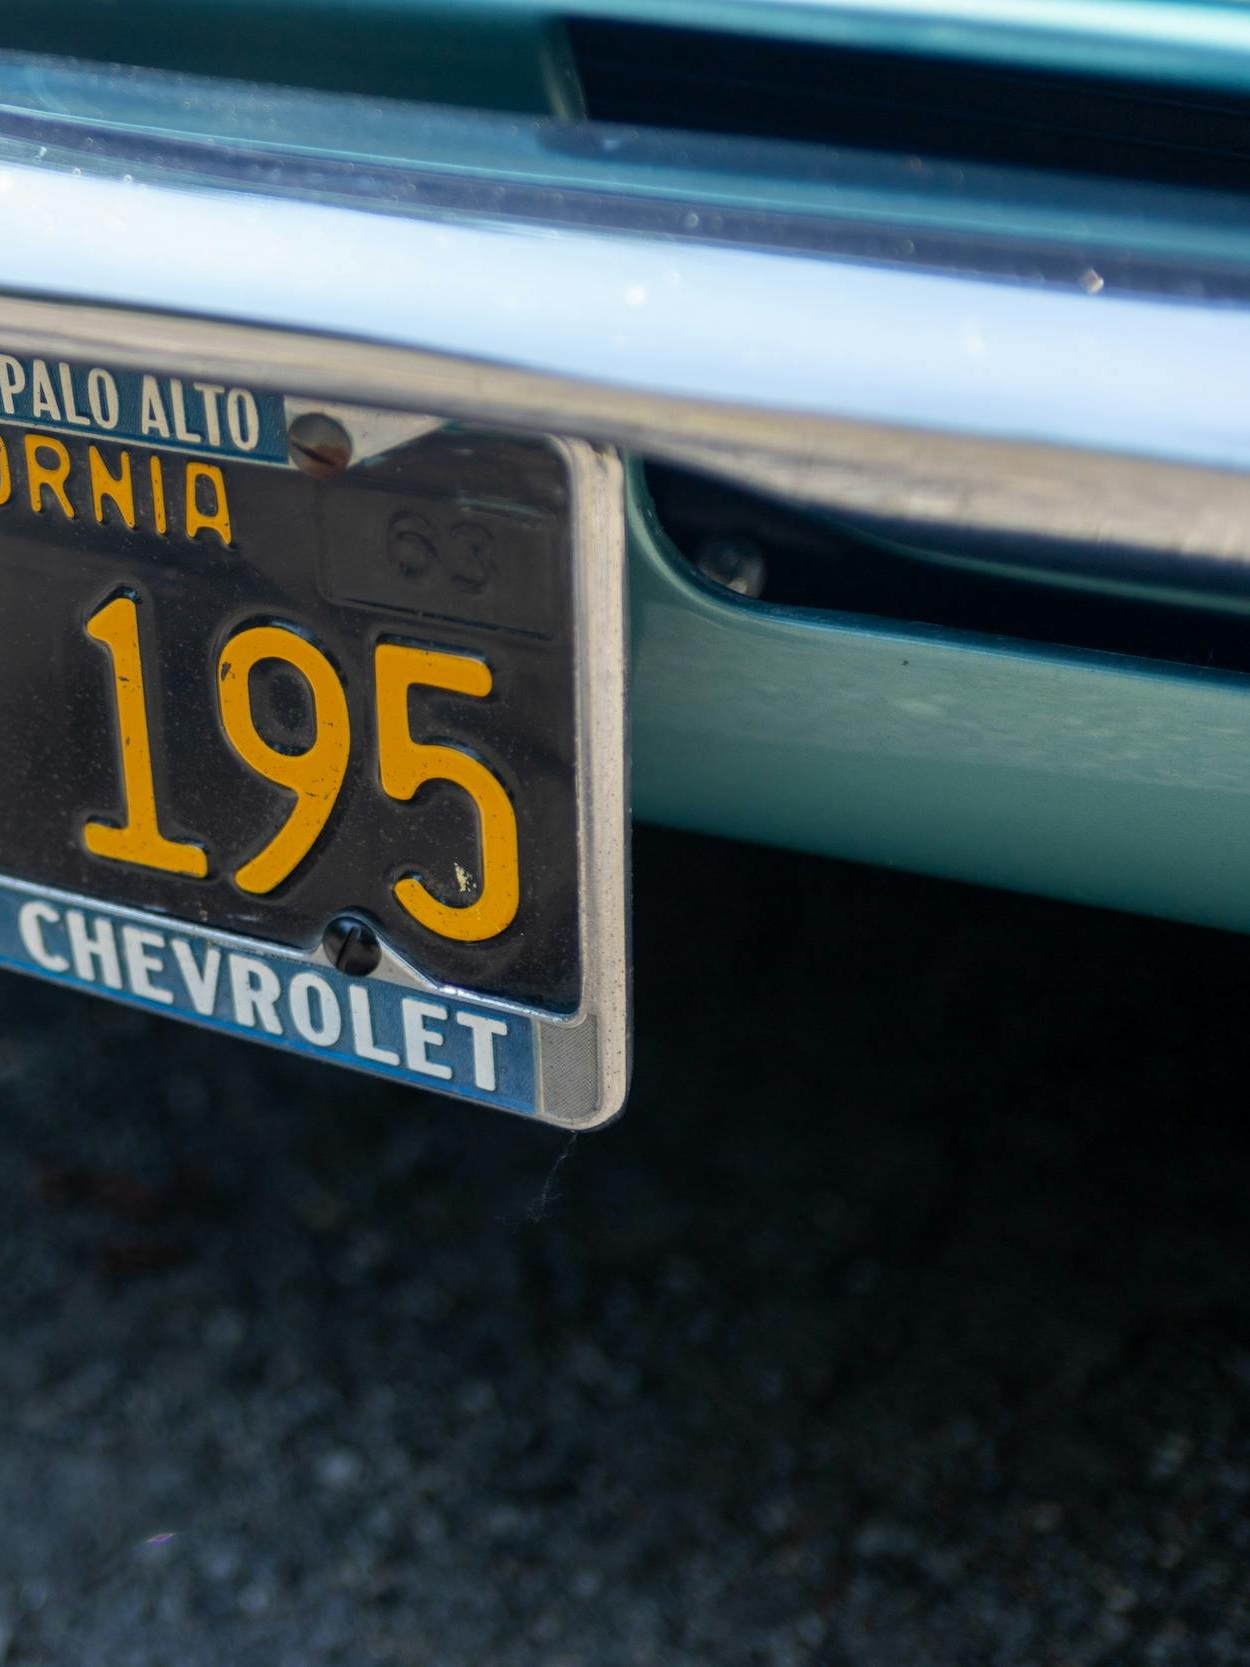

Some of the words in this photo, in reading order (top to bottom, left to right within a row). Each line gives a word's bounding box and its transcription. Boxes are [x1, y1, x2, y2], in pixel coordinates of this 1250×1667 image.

[141, 374, 260, 452] ALTO
[84, 595, 522, 943] 195
[18, 902, 508, 1092] CHEVROLET
